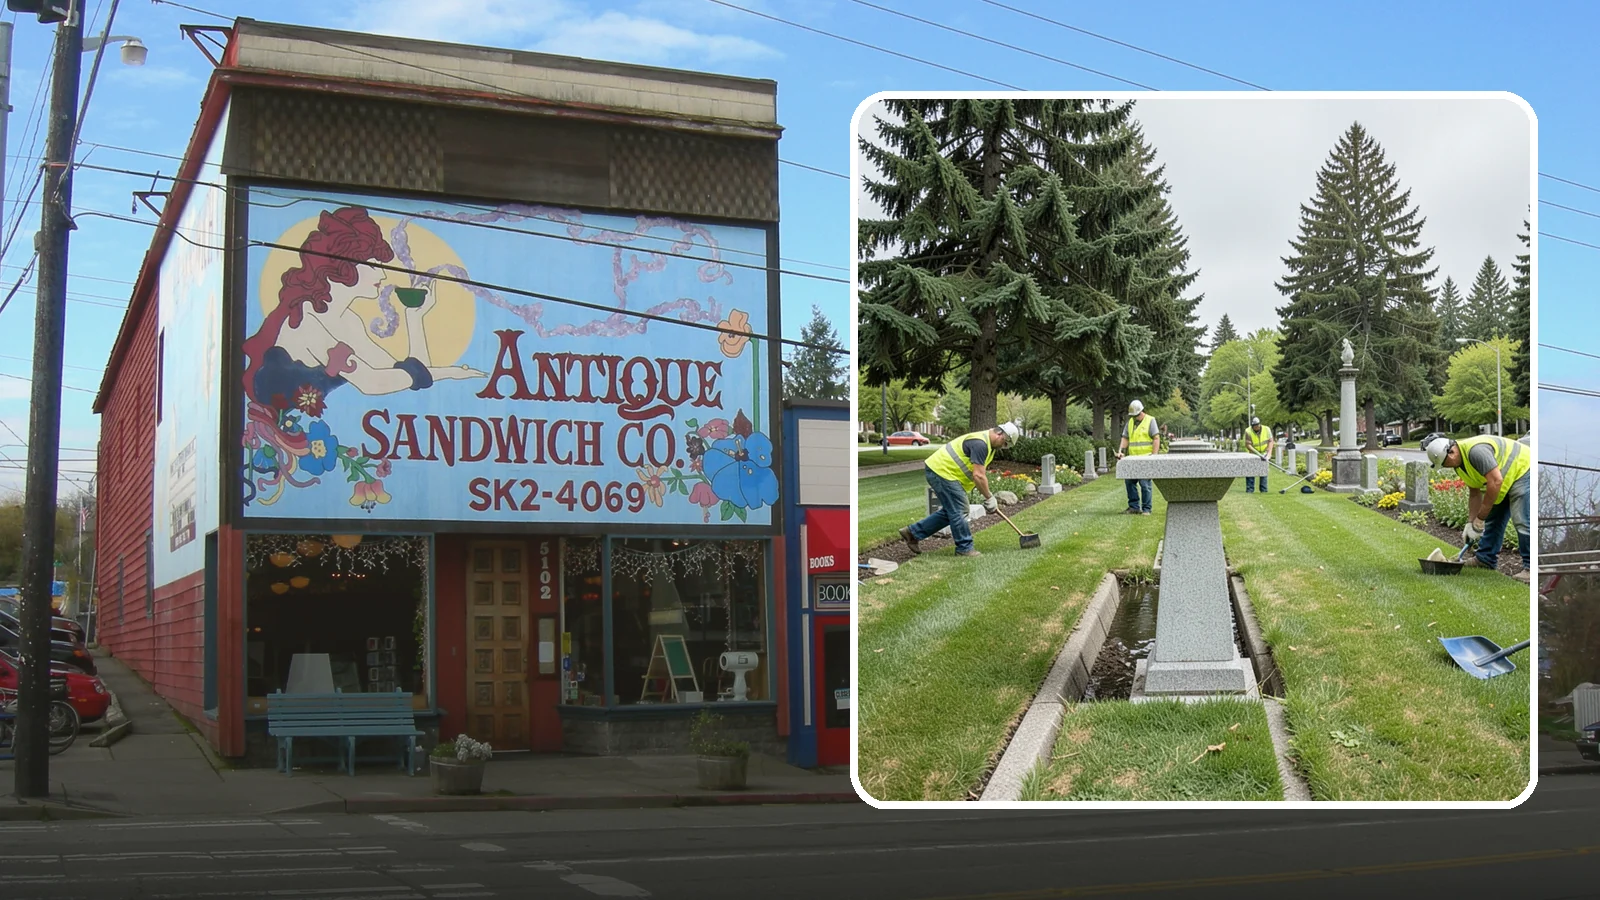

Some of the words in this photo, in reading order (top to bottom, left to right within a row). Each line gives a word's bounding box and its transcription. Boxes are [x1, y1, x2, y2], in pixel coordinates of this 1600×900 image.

[476, 330, 723, 421] ANTIQUE
[362, 409, 604, 467] SANDWICH
[617, 422, 684, 468] CO.
[468, 477, 646, 513] SK2-4069
[540, 541, 551, 600] 5102
[810, 555, 835, 569] BOOKS
